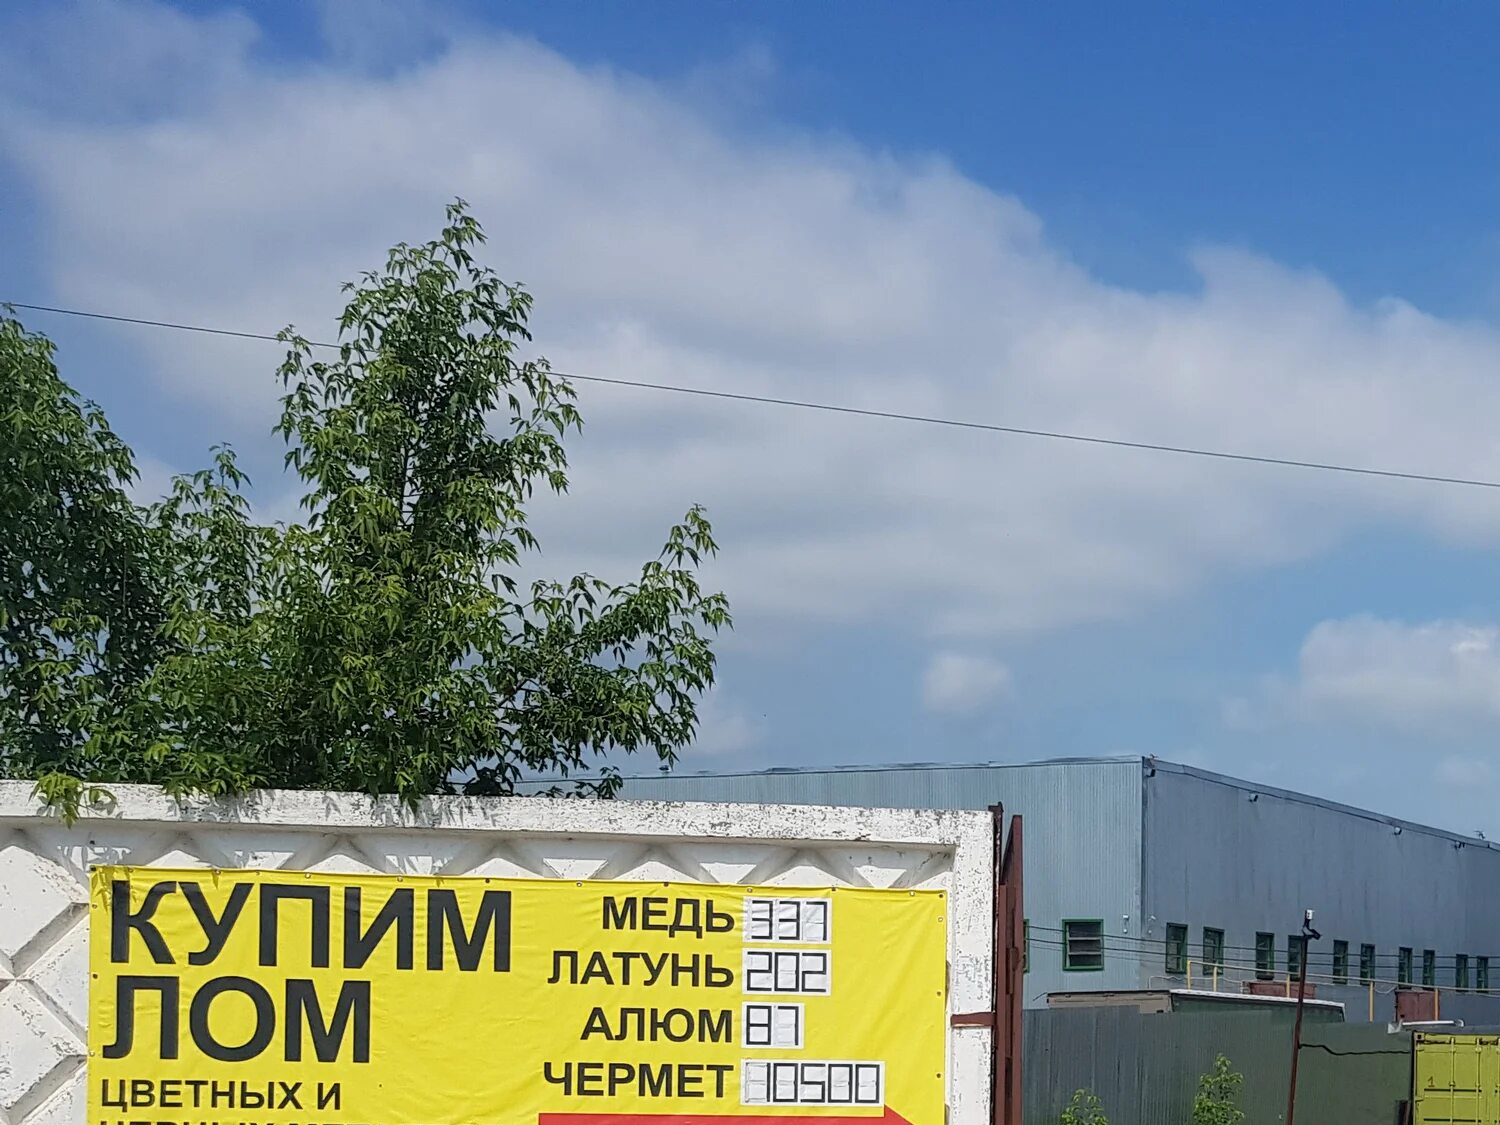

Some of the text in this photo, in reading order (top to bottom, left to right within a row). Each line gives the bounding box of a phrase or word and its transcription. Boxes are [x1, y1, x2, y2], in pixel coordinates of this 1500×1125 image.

[110, 880, 512, 973] КУПИМ
[601, 896, 828, 941] МЕДЬ 337
[547, 950, 827, 993] ЛАТУНЬ 202
[102, 975, 372, 1064] ЛОМ
[580, 1005, 799, 1046] АЛЮМ 87
[101, 1079, 342, 1113] ЦВЕТНЫХ И
[543, 1061, 881, 1104] ЧЕРМЕТ 10500
[1427, 1076, 1436, 1088] 1
